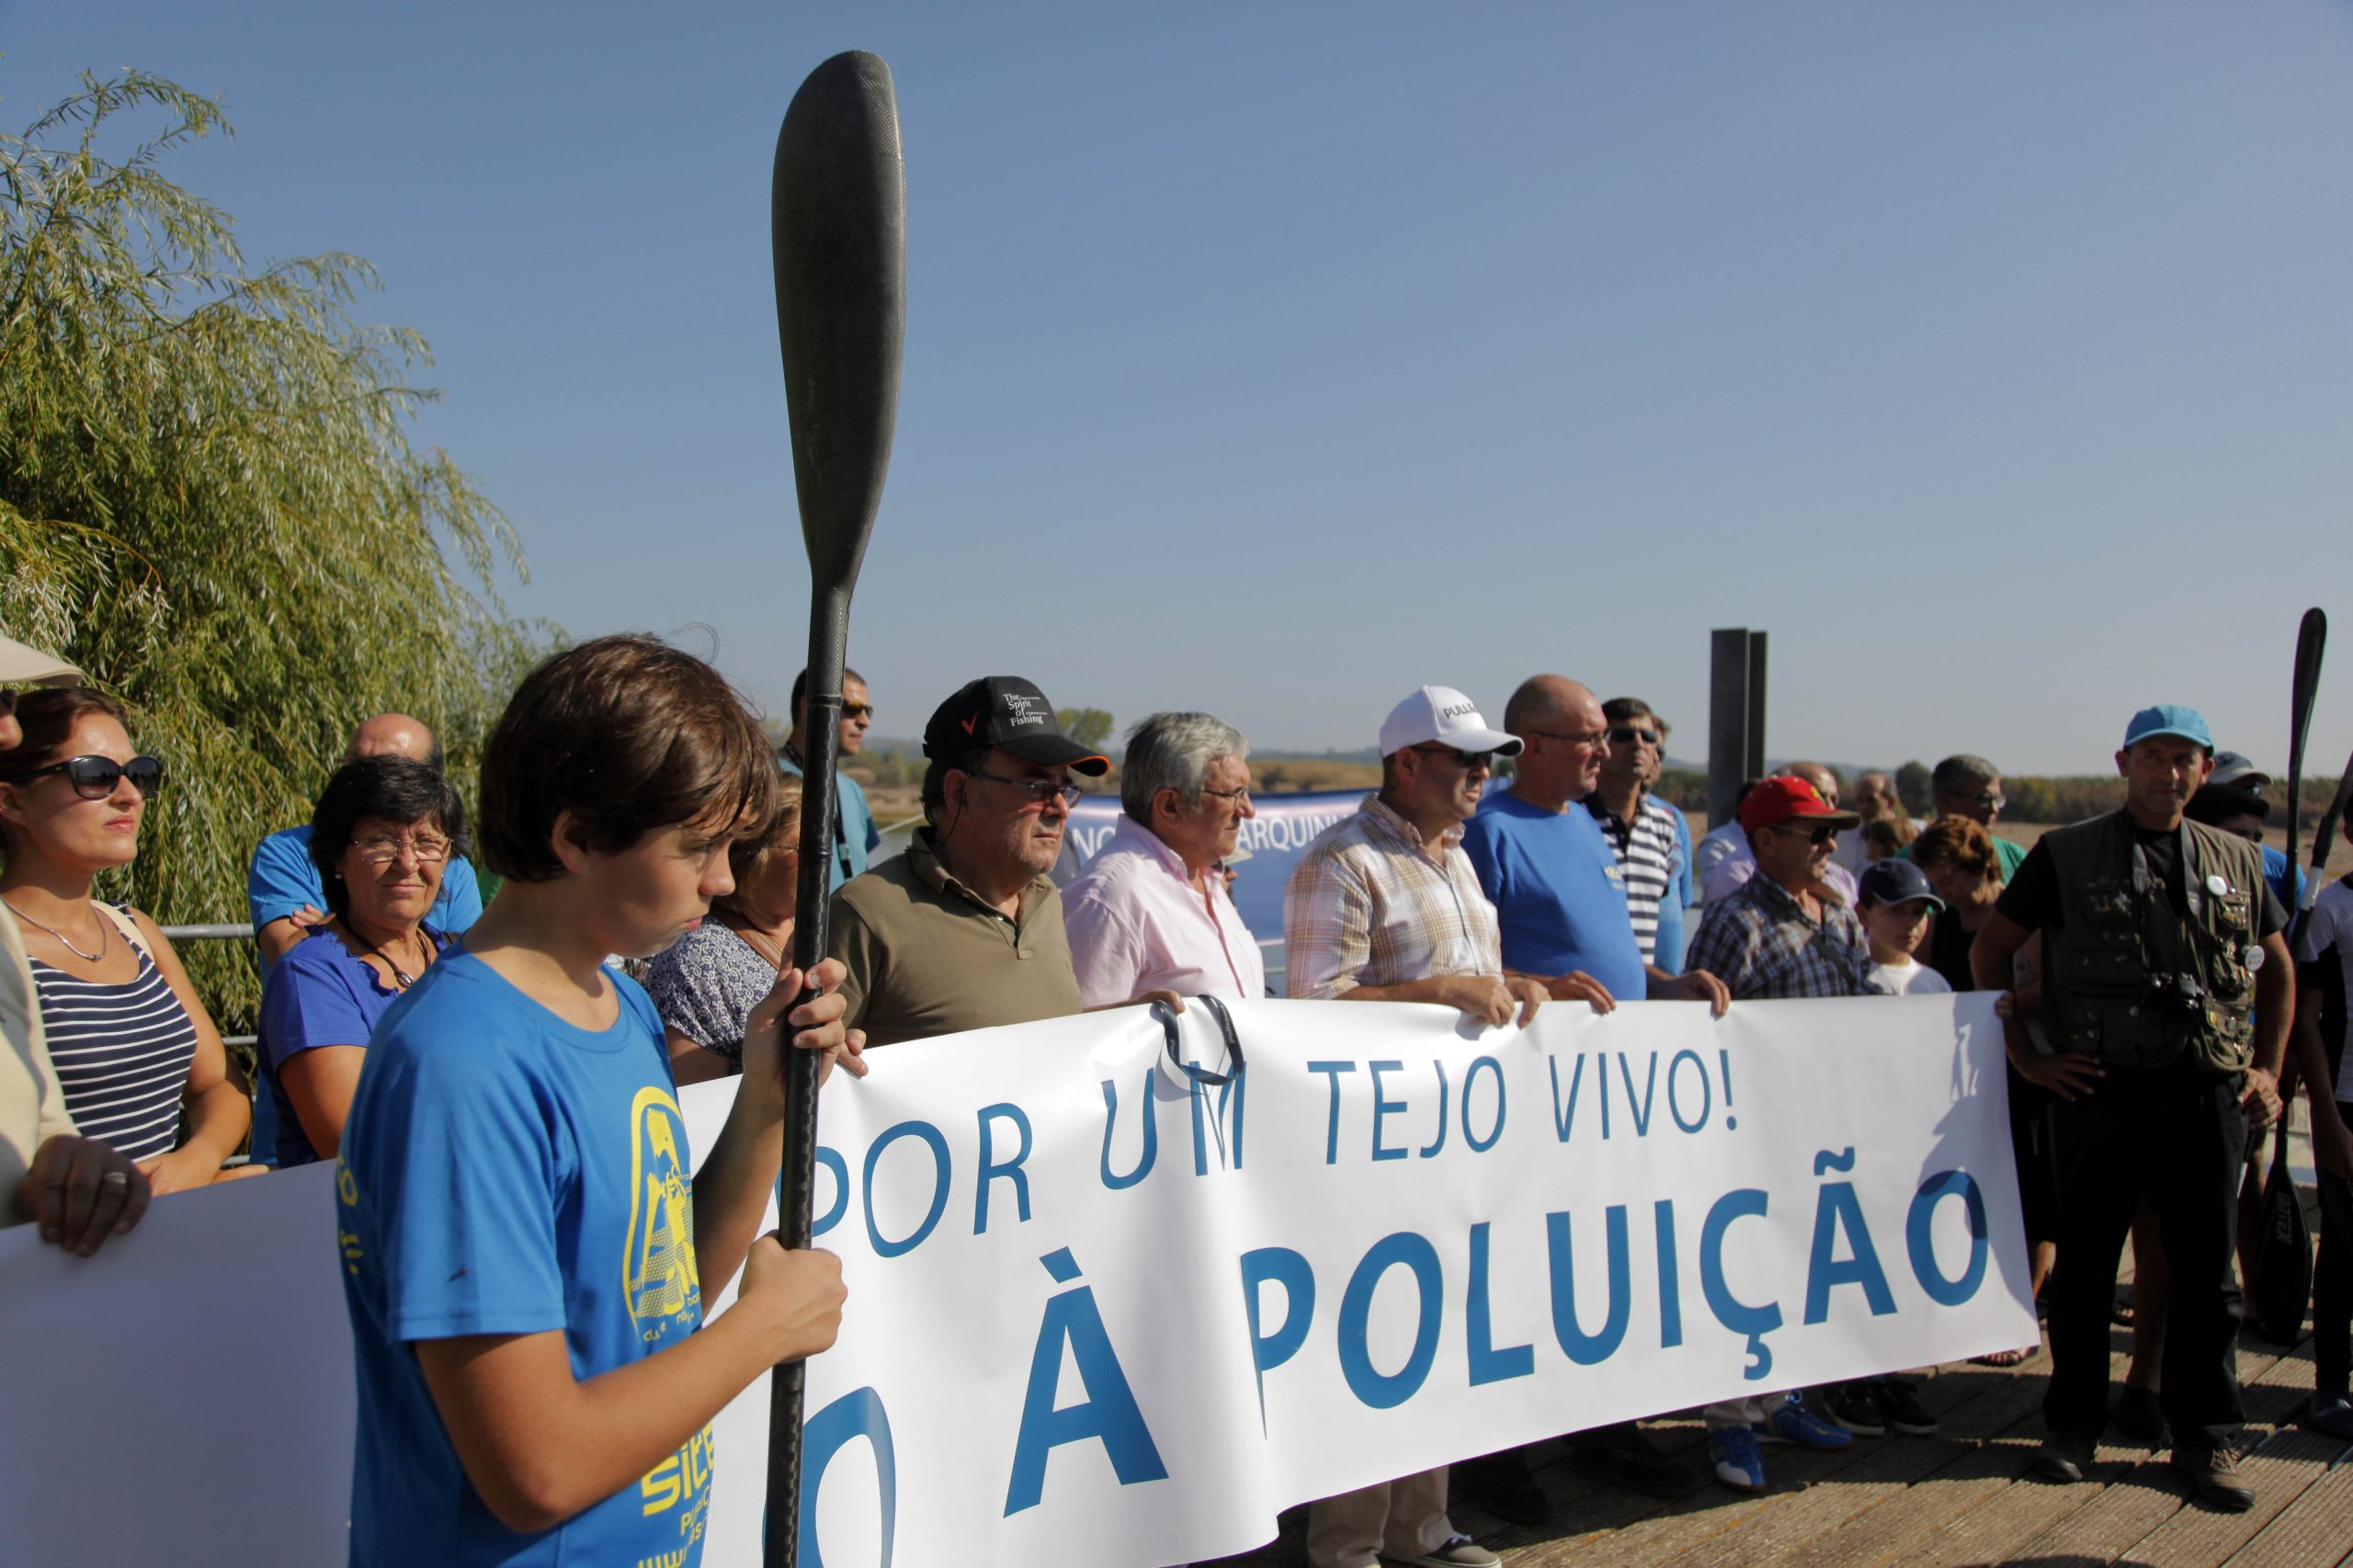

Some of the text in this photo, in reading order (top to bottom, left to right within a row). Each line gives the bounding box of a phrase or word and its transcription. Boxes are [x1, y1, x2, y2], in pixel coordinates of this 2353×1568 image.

[1003, 693, 1020, 701] The
[1007, 699, 1032, 710] Spirit
[1016, 707, 1025, 717] of
[1010, 715, 1044, 726] Fishing
[1100, 1060, 1247, 1189] UM
[1307, 1054, 1507, 1165] TEJO
[1549, 1049, 1737, 1142] VIVO!
[1003, 1246, 1169, 1518] À
[1239, 1147, 1989, 1439] POLUIÇÃO
